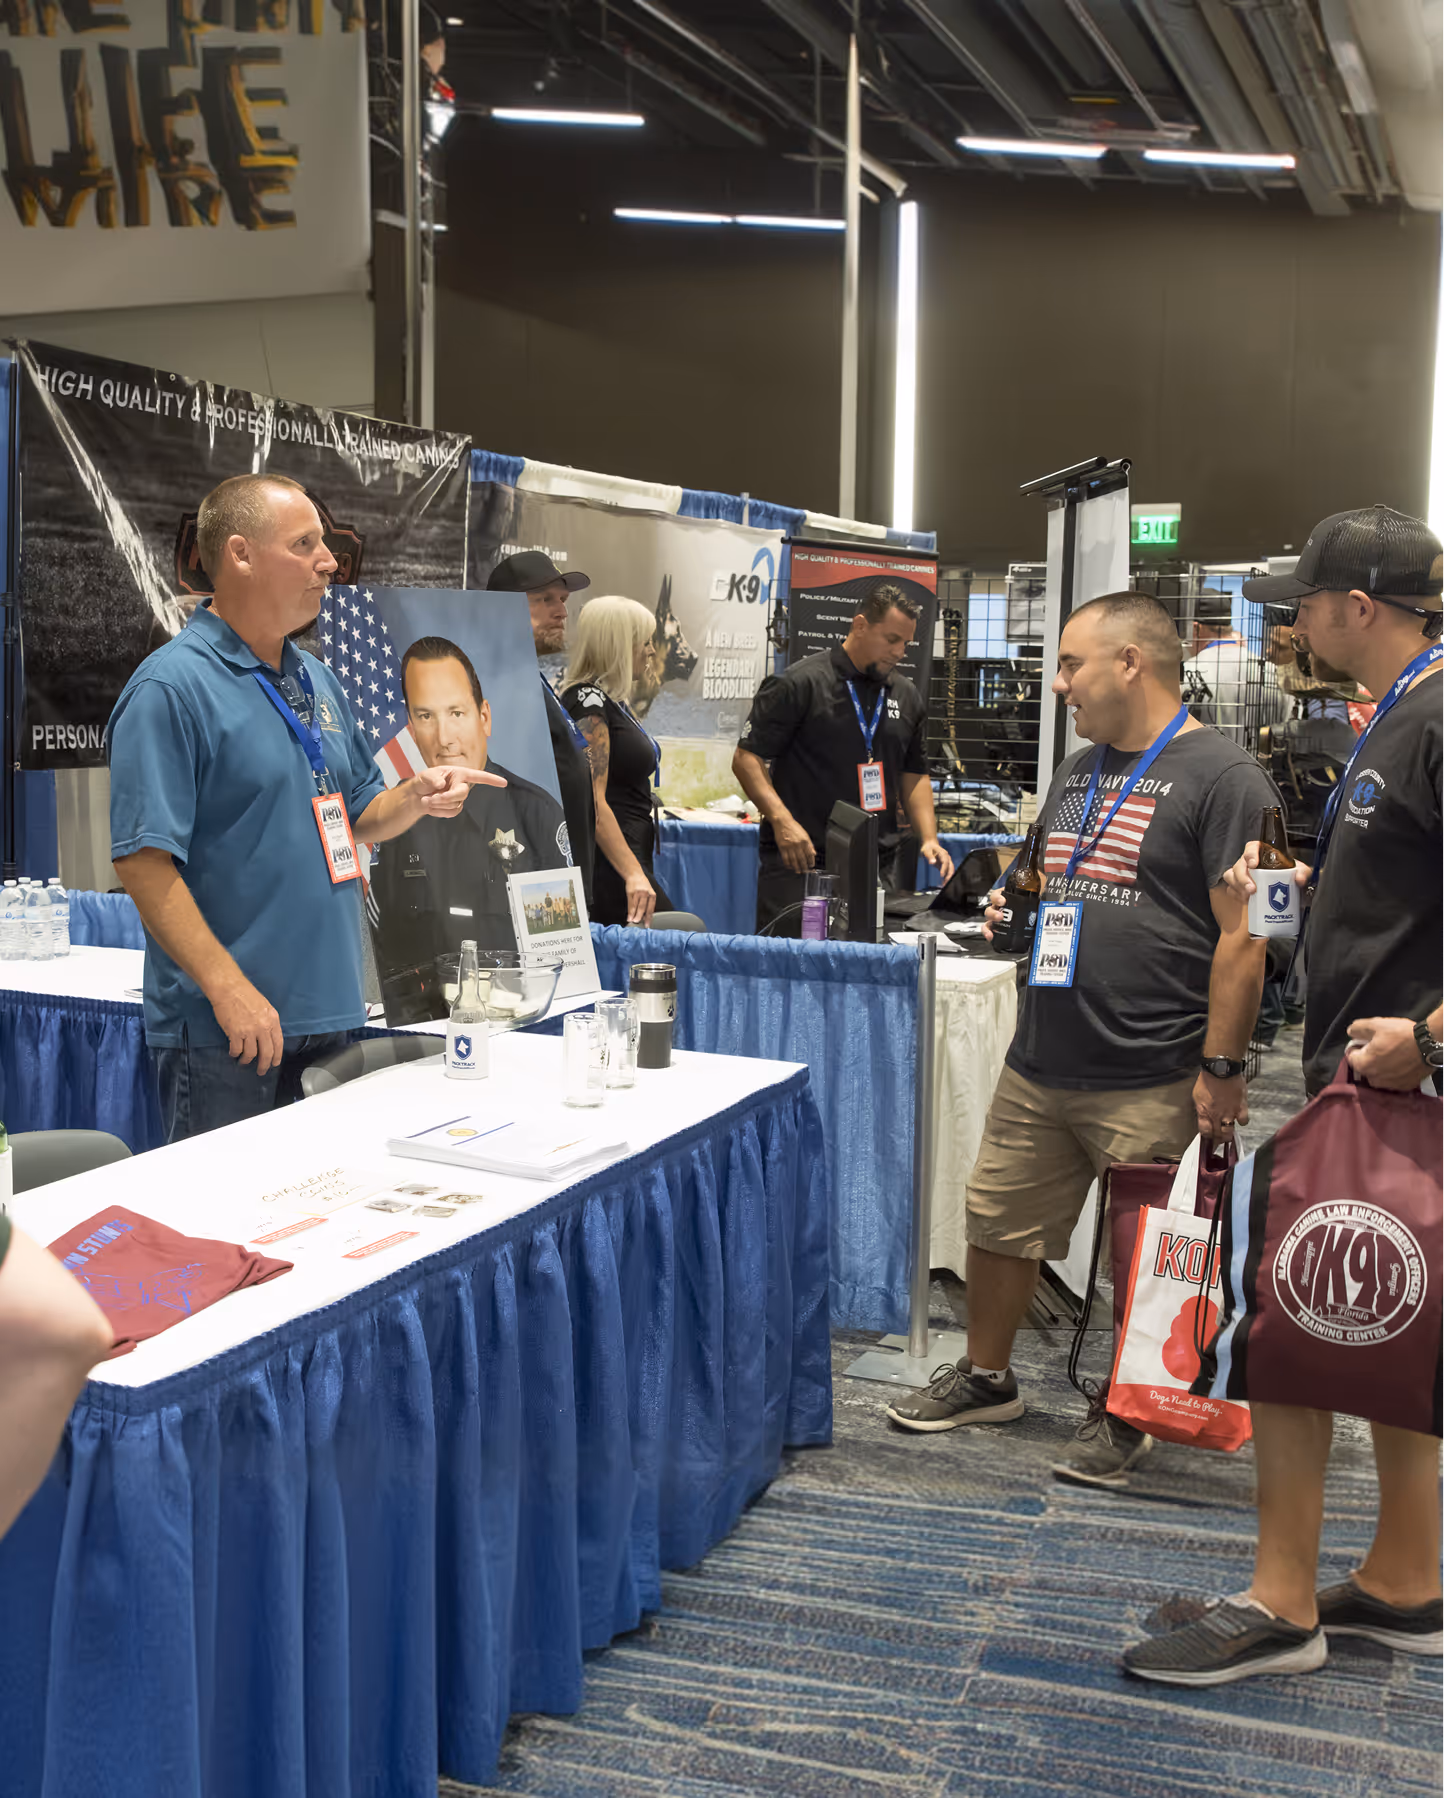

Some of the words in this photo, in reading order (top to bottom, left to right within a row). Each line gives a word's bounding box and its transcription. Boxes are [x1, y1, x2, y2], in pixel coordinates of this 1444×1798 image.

[36, 364, 93, 400] HIGH
[100, 379, 187, 420] QUALITY
[1139, 516, 1172, 540] EXIT
[794, 553, 809, 561] HIGH
[810, 555, 834, 564] QUALITY
[798, 630, 826, 639] PATROL
[703, 677, 755, 700] BLOODLINE
[888, 709, 900, 719] K9
[1066, 774, 1092, 787] OLD
[1132, 778, 1173, 796] 2014
[1086, 893, 1108, 902] SINCE
[1111, 898, 1130, 906] 1994
[531, 939, 560, 949] DONATIONS
[560, 936, 573, 944] HERE
[552, 948, 570, 956] FAMILY
[1294, 1210, 1325, 1237] CANINE
[1326, 1205, 1350, 1218] LAW
[1351, 1205, 1416, 1256] ENFORCEMENT
[1406, 1256, 1421, 1306] OFFICERS
[1387, 1262, 1402, 1296] Georgia
[1337, 1308, 1369, 1321] Florida
[1296, 1309, 1343, 1340] TRAINING
[1346, 1326, 1388, 1342] CENTER
[1150, 1390, 1170, 1404] Dogs
[1171, 1395, 1192, 1407] Need
[1193, 1400, 1201, 1409] to
